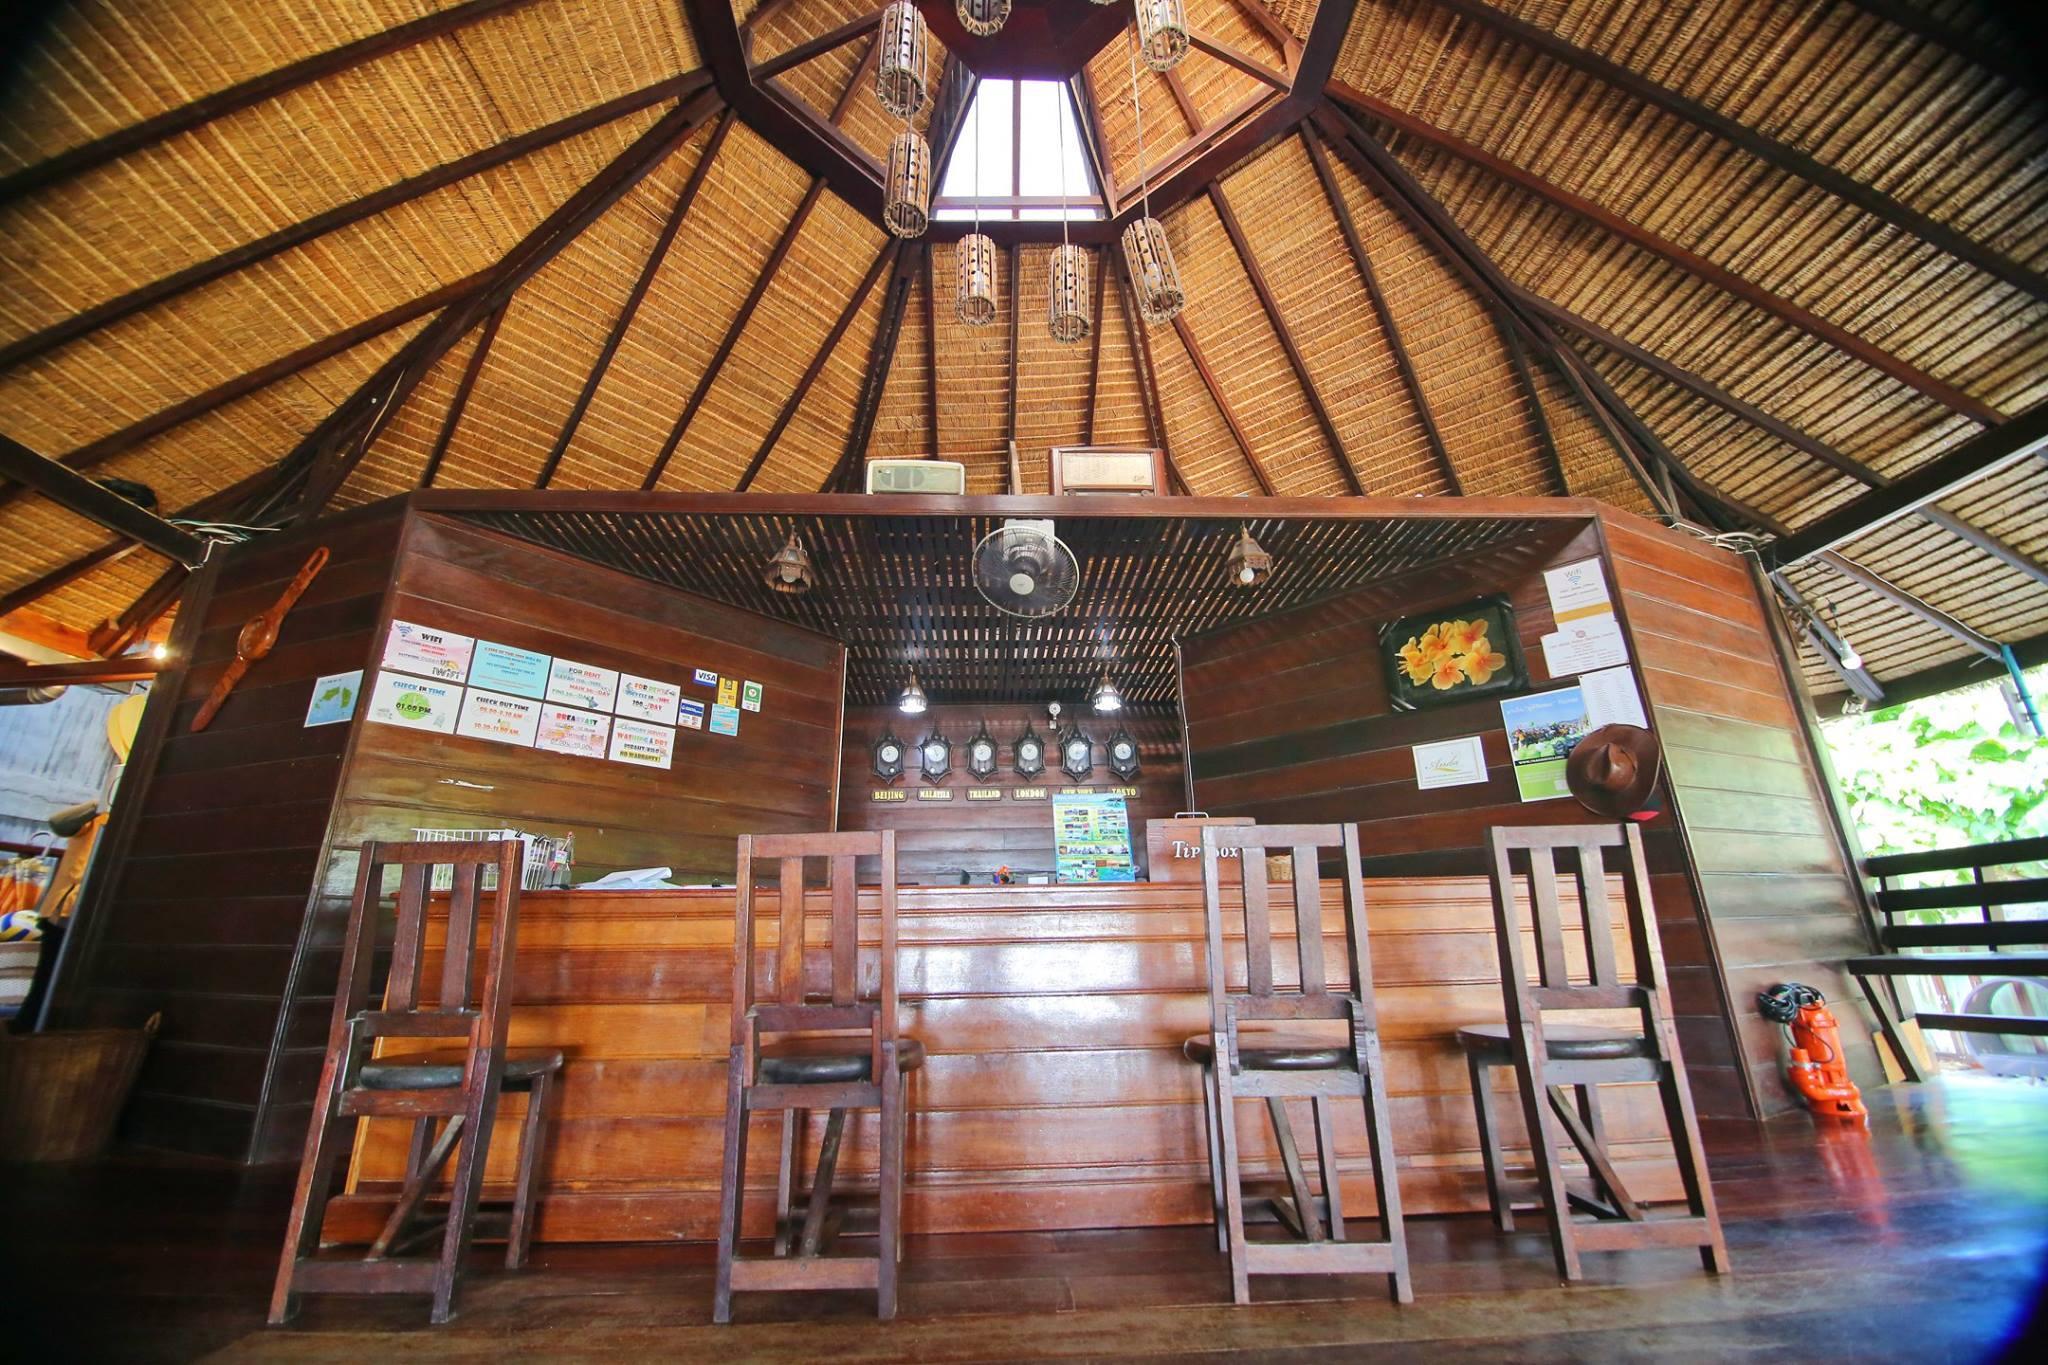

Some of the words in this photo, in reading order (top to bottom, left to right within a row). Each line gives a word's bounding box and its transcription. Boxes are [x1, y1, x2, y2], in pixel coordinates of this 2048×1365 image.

[698, 672, 716, 682] VISA
[393, 681, 417, 690] CHECK
[428, 688, 446, 696] TIME
[476, 696, 498, 705] CHECK
[499, 700, 512, 708] OUT
[514, 704, 529, 712] TIME
[874, 790, 904, 800] BEIJING
[920, 790, 950, 798] MALAYSIA
[969, 790, 1001, 798] THAILAND
[1016, 788, 1045, 798] LONDON
[1112, 788, 1136, 796] TOKYO
[1172, 840, 1200, 858] Tip
[1216, 847, 1238, 858] ox
